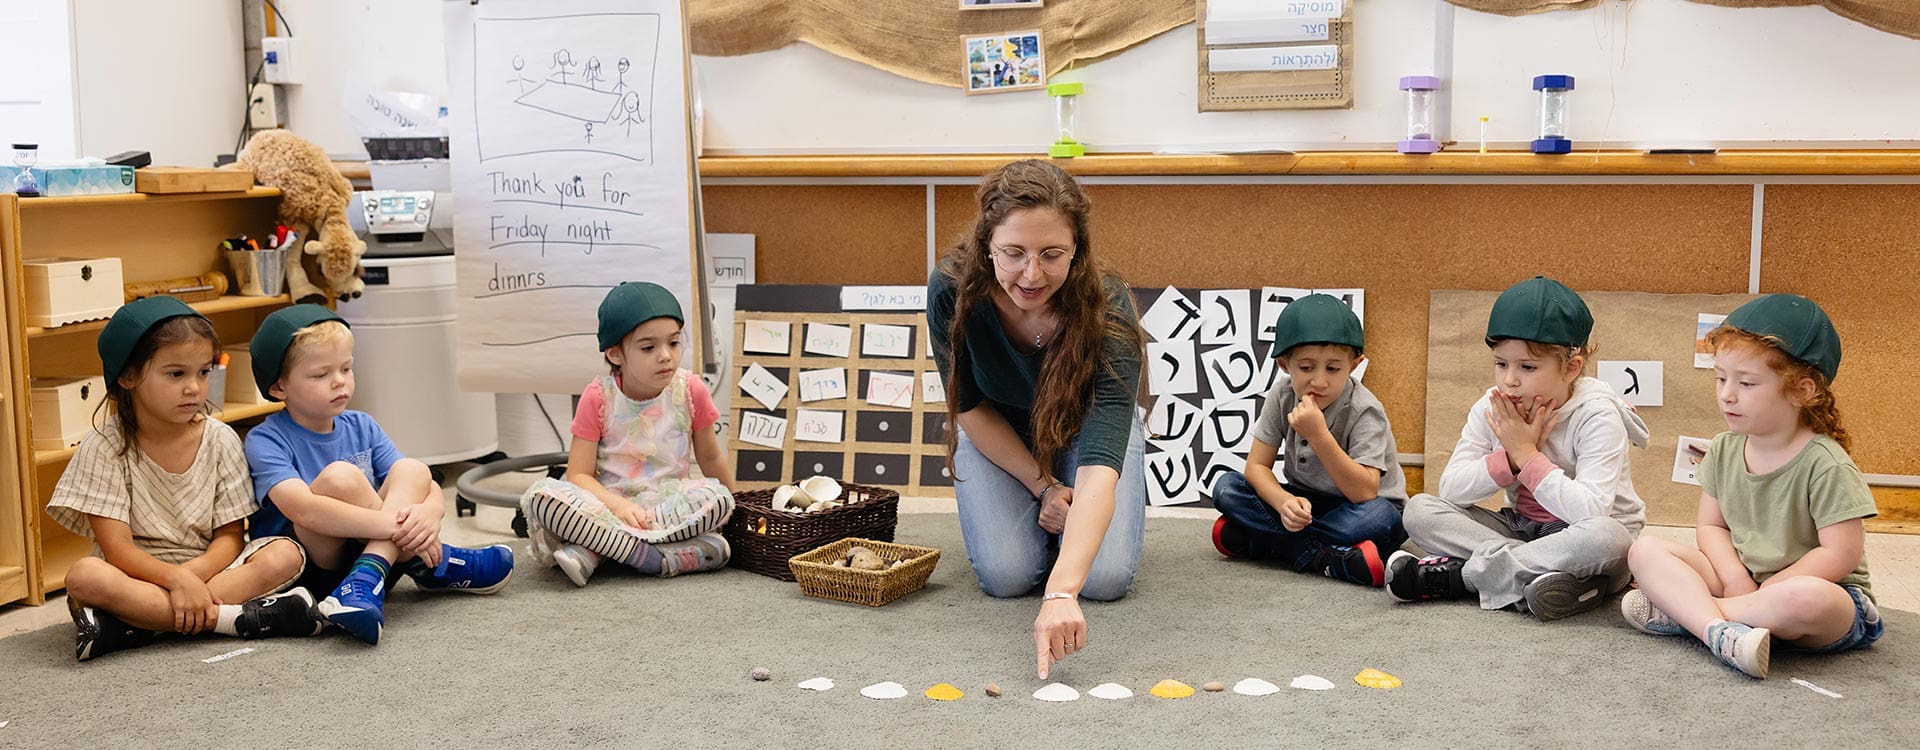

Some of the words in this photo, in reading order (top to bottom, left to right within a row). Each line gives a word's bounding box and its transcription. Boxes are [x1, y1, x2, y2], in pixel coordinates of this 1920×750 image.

[487, 171, 546, 196] Thank
[554, 175, 586, 210] you
[602, 173, 631, 206] for
[490, 214, 550, 257] Friday
[567, 219, 613, 255] night
[488, 262, 546, 292] dinnrs
[1215, 295, 1237, 338] ג
[1161, 352, 1180, 382] י
[1212, 350, 1255, 394] ט
[1623, 366, 1640, 396] ג
[1149, 403, 1194, 441] ע
[1209, 407, 1250, 449] ס
[1149, 453, 1191, 499] ש
